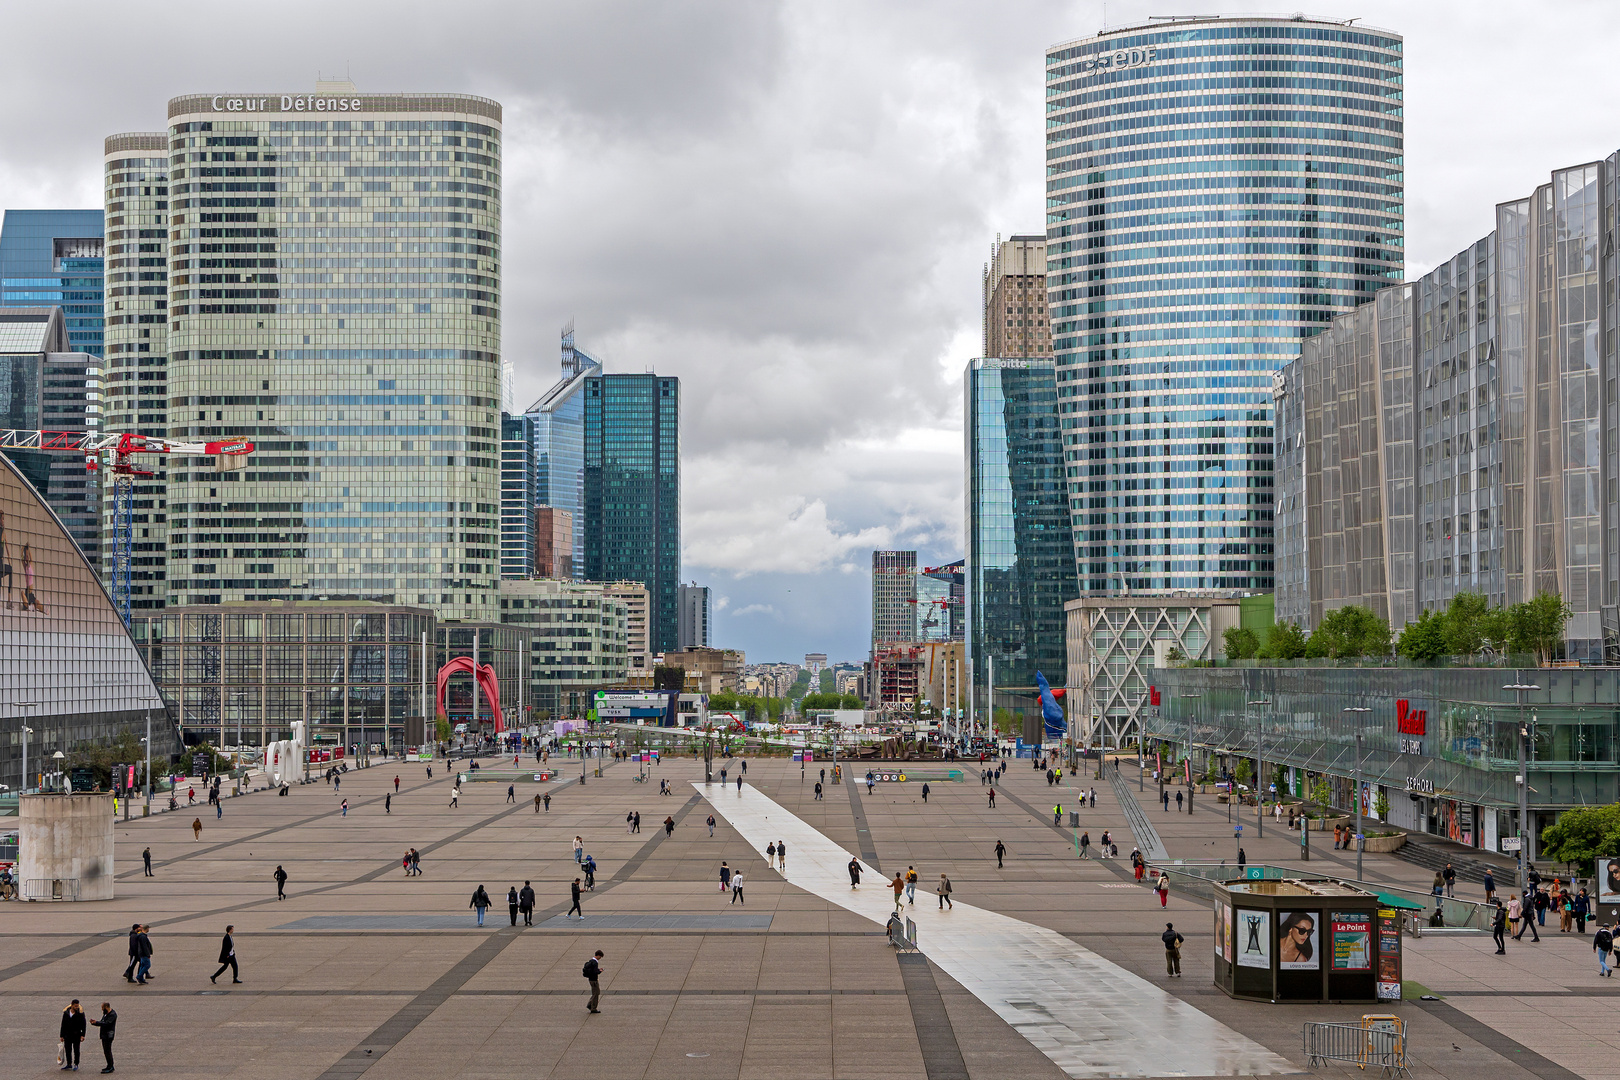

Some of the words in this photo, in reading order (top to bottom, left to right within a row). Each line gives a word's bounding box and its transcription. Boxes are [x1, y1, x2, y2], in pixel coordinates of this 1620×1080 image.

[212, 95, 267, 111] Cœur
[281, 94, 362, 111] Défense
[1396, 698, 1427, 736] Westfield
[1407, 777, 1434, 793] SEPHORA
